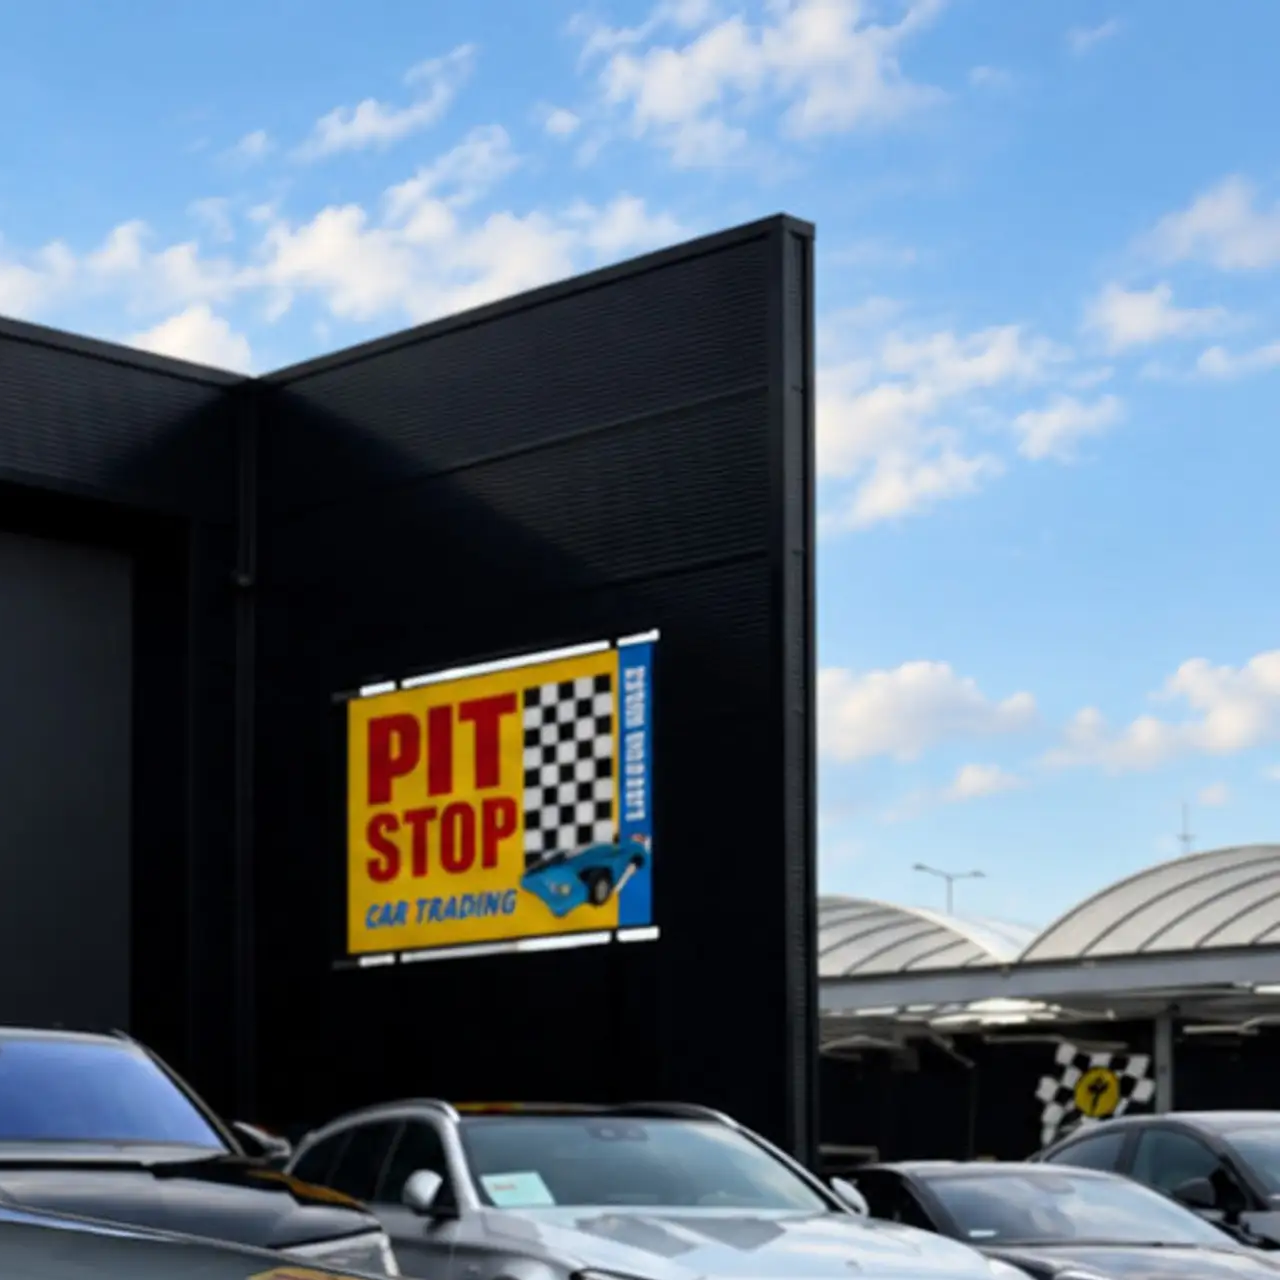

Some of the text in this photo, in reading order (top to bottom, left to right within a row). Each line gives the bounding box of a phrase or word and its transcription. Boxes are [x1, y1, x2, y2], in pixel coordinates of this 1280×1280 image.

[367, 691, 517, 806] PIT
[366, 796, 517, 883] STOP
[366, 889, 517, 930] CAR TRADING
